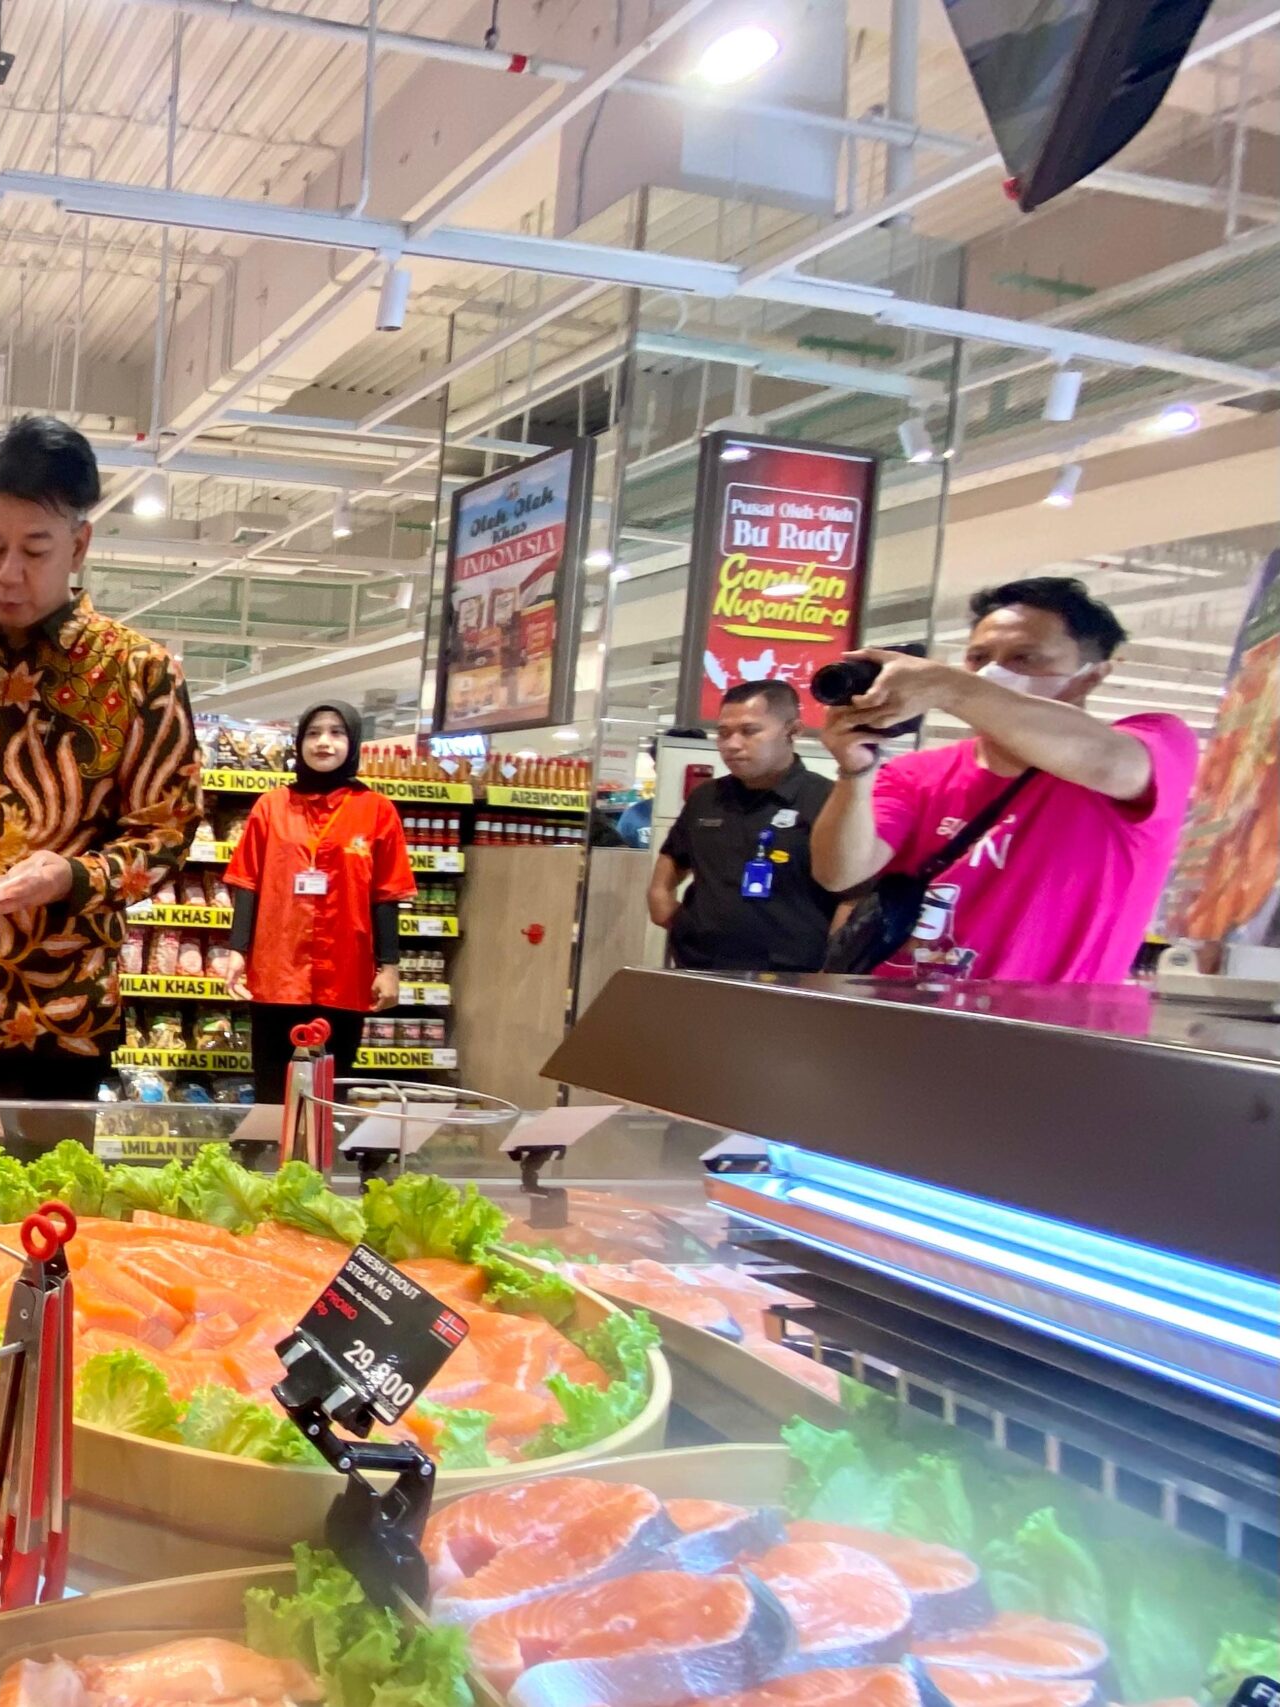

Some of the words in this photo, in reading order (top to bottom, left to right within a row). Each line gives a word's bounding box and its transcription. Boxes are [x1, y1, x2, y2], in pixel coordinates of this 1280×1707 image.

[731, 499, 775, 517] Pusat
[779, 503, 853, 522] Oleh-Oleh
[462, 531, 556, 577] INDONESIA
[732, 520, 770, 547] Bu
[777, 523, 850, 561] Rudy
[719, 553, 846, 599] Camilan
[713, 587, 850, 626] Nusantara
[371, 782, 450, 799] INDONESIA
[172, 910, 211, 924] KHAS
[165, 980, 206, 995] KHAS
[167, 1054, 208, 1068] KHAS
[345, 1260, 378, 1289] STEAK
[375, 1283, 393, 1300] KG
[355, 1247, 387, 1275] FRESH
[385, 1269, 421, 1300] TROUT
[324, 1288, 358, 1320] PROMO
